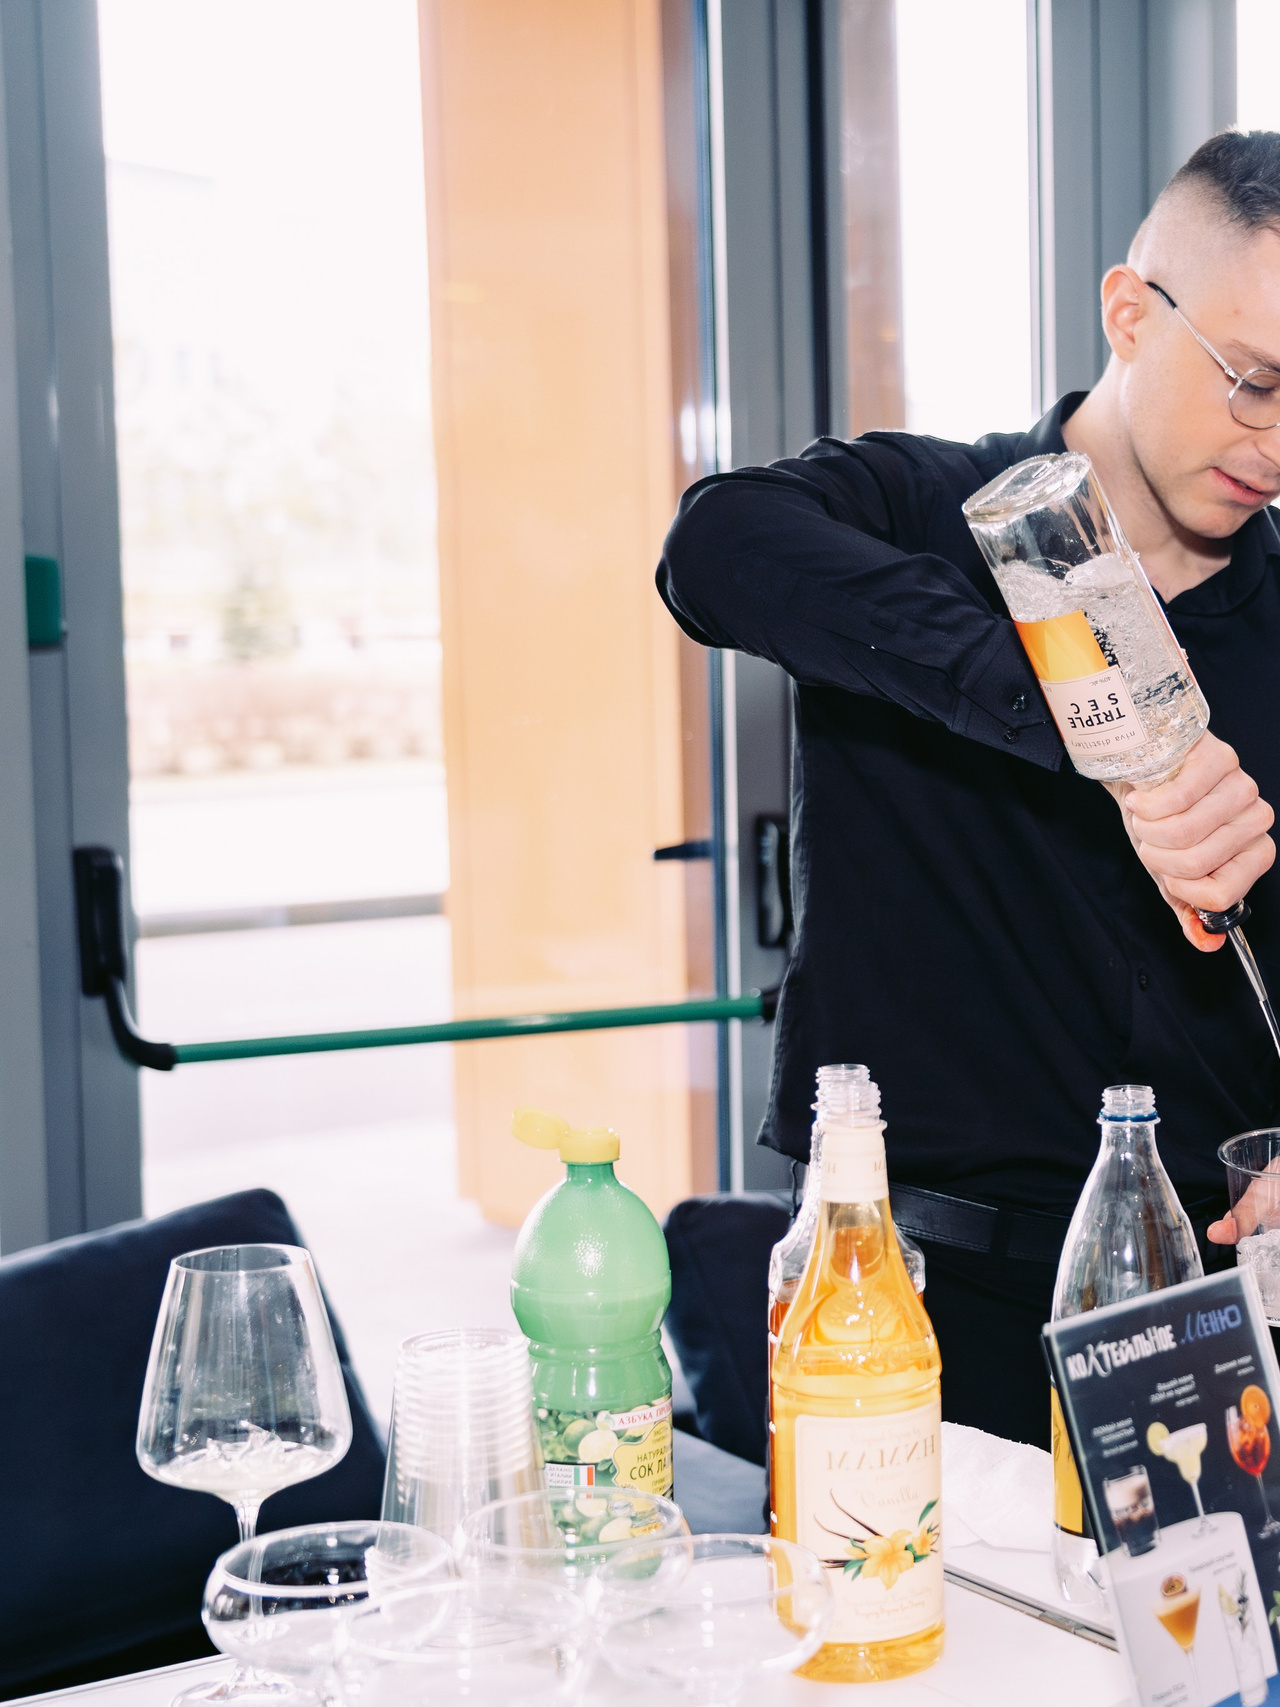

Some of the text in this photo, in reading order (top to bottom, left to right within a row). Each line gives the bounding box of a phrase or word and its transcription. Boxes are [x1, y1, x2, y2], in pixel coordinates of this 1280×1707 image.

[1068, 707, 1126, 729] TRIPLE
[1072, 731, 1136, 750] niva distillery
[619, 1413, 653, 1426] АЗБУКА
[630, 1462, 654, 1481] СОК
